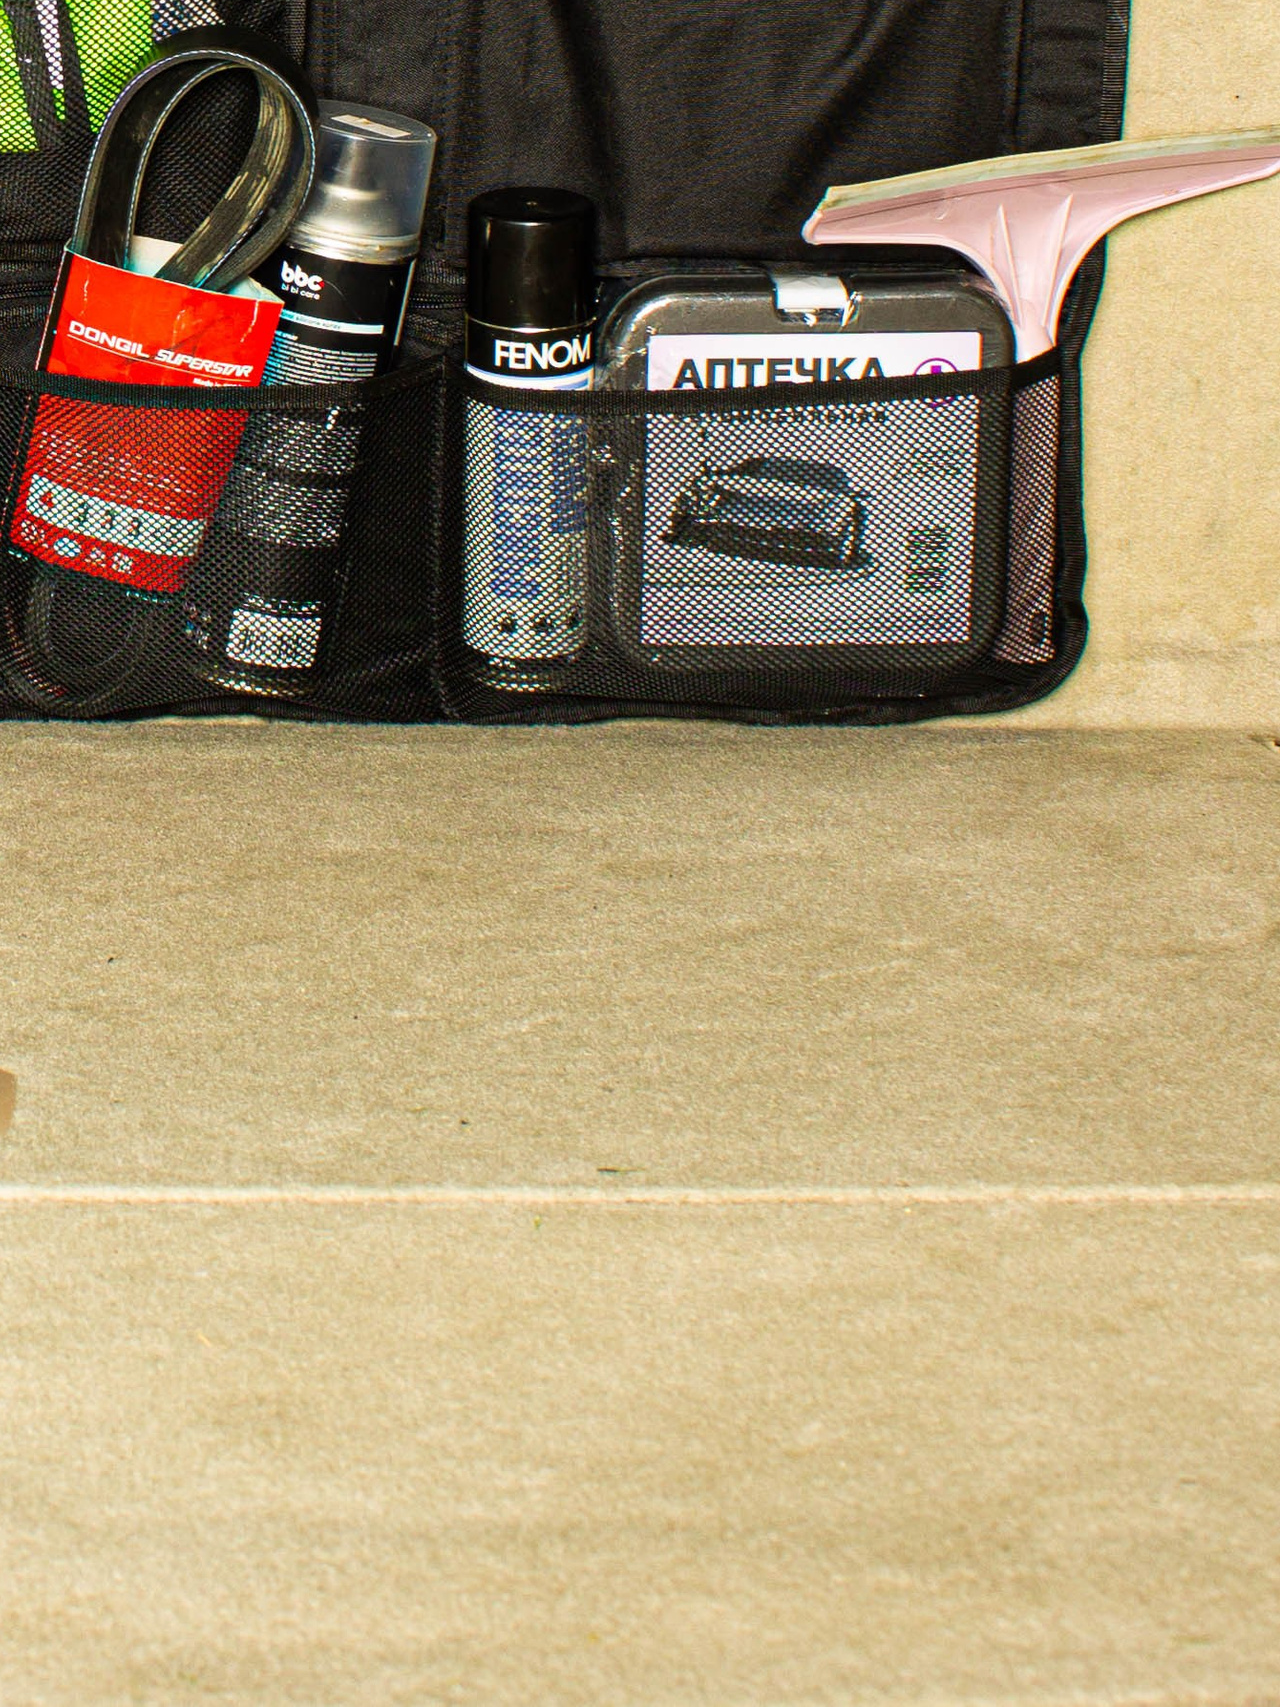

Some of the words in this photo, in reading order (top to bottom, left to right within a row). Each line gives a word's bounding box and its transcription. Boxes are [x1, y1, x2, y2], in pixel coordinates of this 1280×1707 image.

[281, 260, 324, 291] bbc
[69, 320, 150, 359] DONGIL
[154, 349, 254, 378] SUPERSTAR
[494, 332, 592, 370] FENOM
[672, 357, 886, 389] АПТЕЧКА
